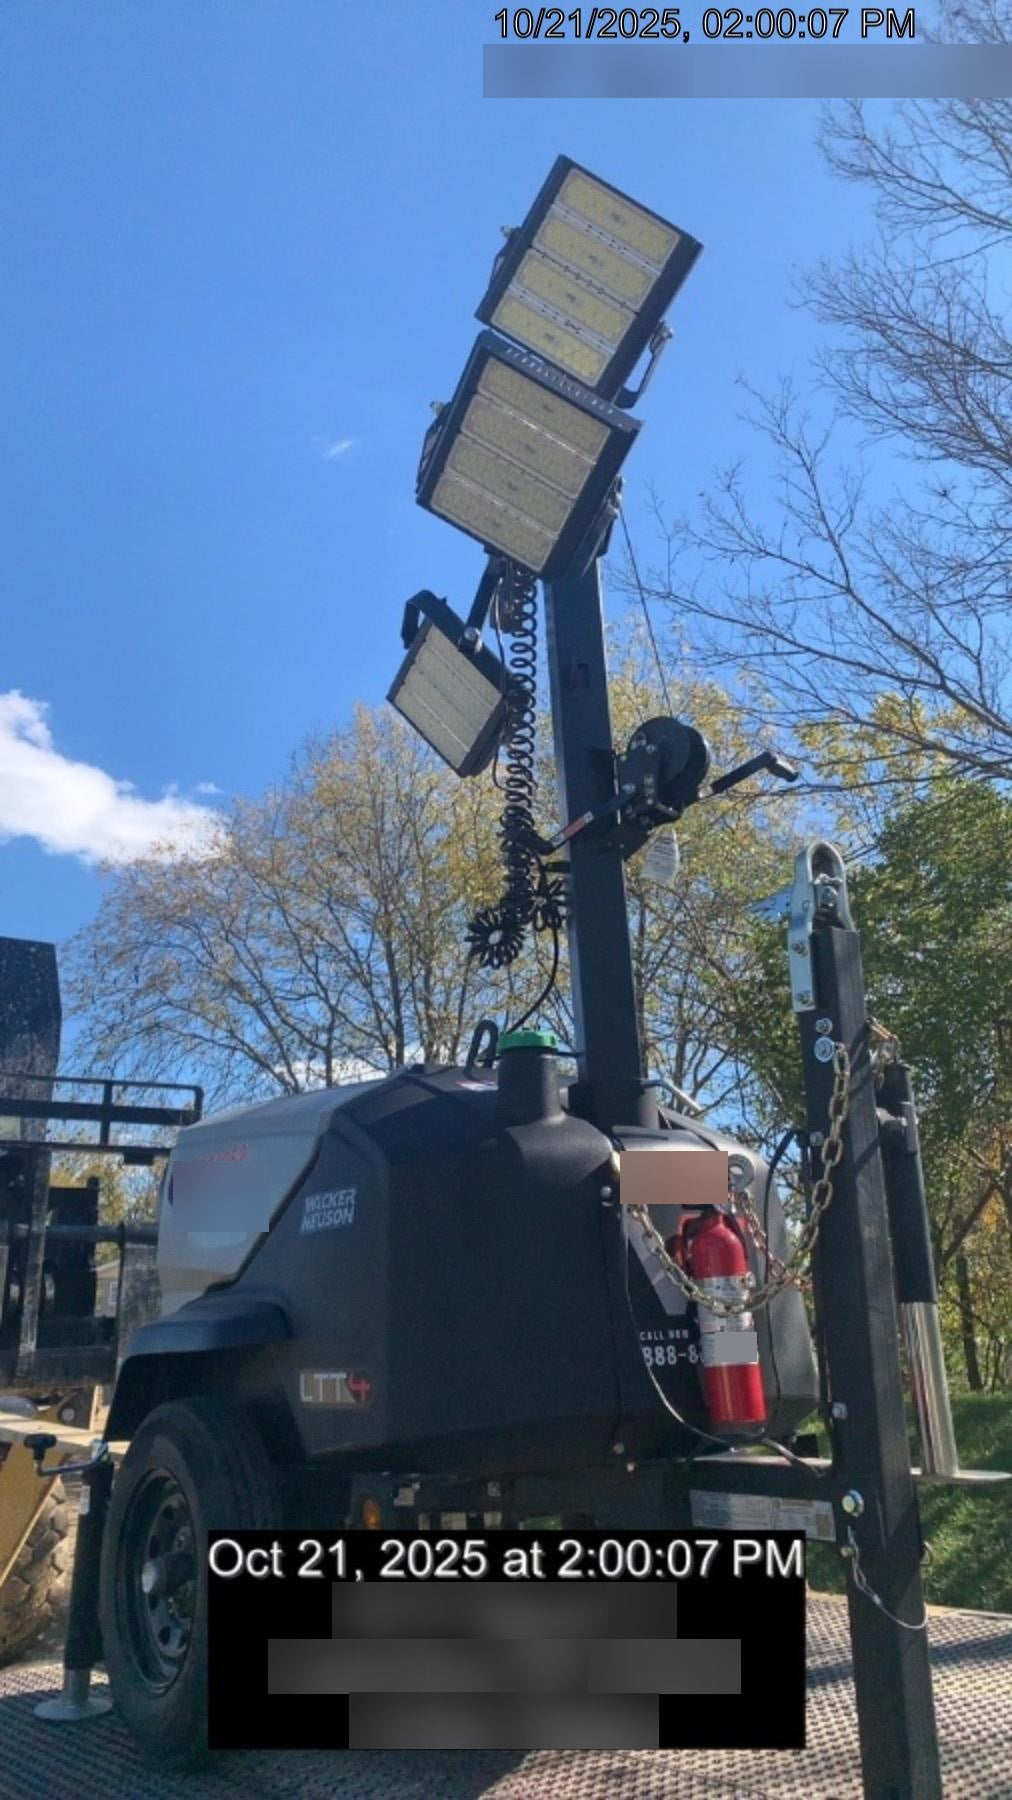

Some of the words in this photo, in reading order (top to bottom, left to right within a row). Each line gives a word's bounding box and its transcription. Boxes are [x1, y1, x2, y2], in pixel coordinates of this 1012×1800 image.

[304, 1188, 356, 1213] WACKER
[300, 1207, 354, 1232] NEUSON
[640, 1329, 665, 1341] CALL
[642, 1344, 703, 1366] 888-8
